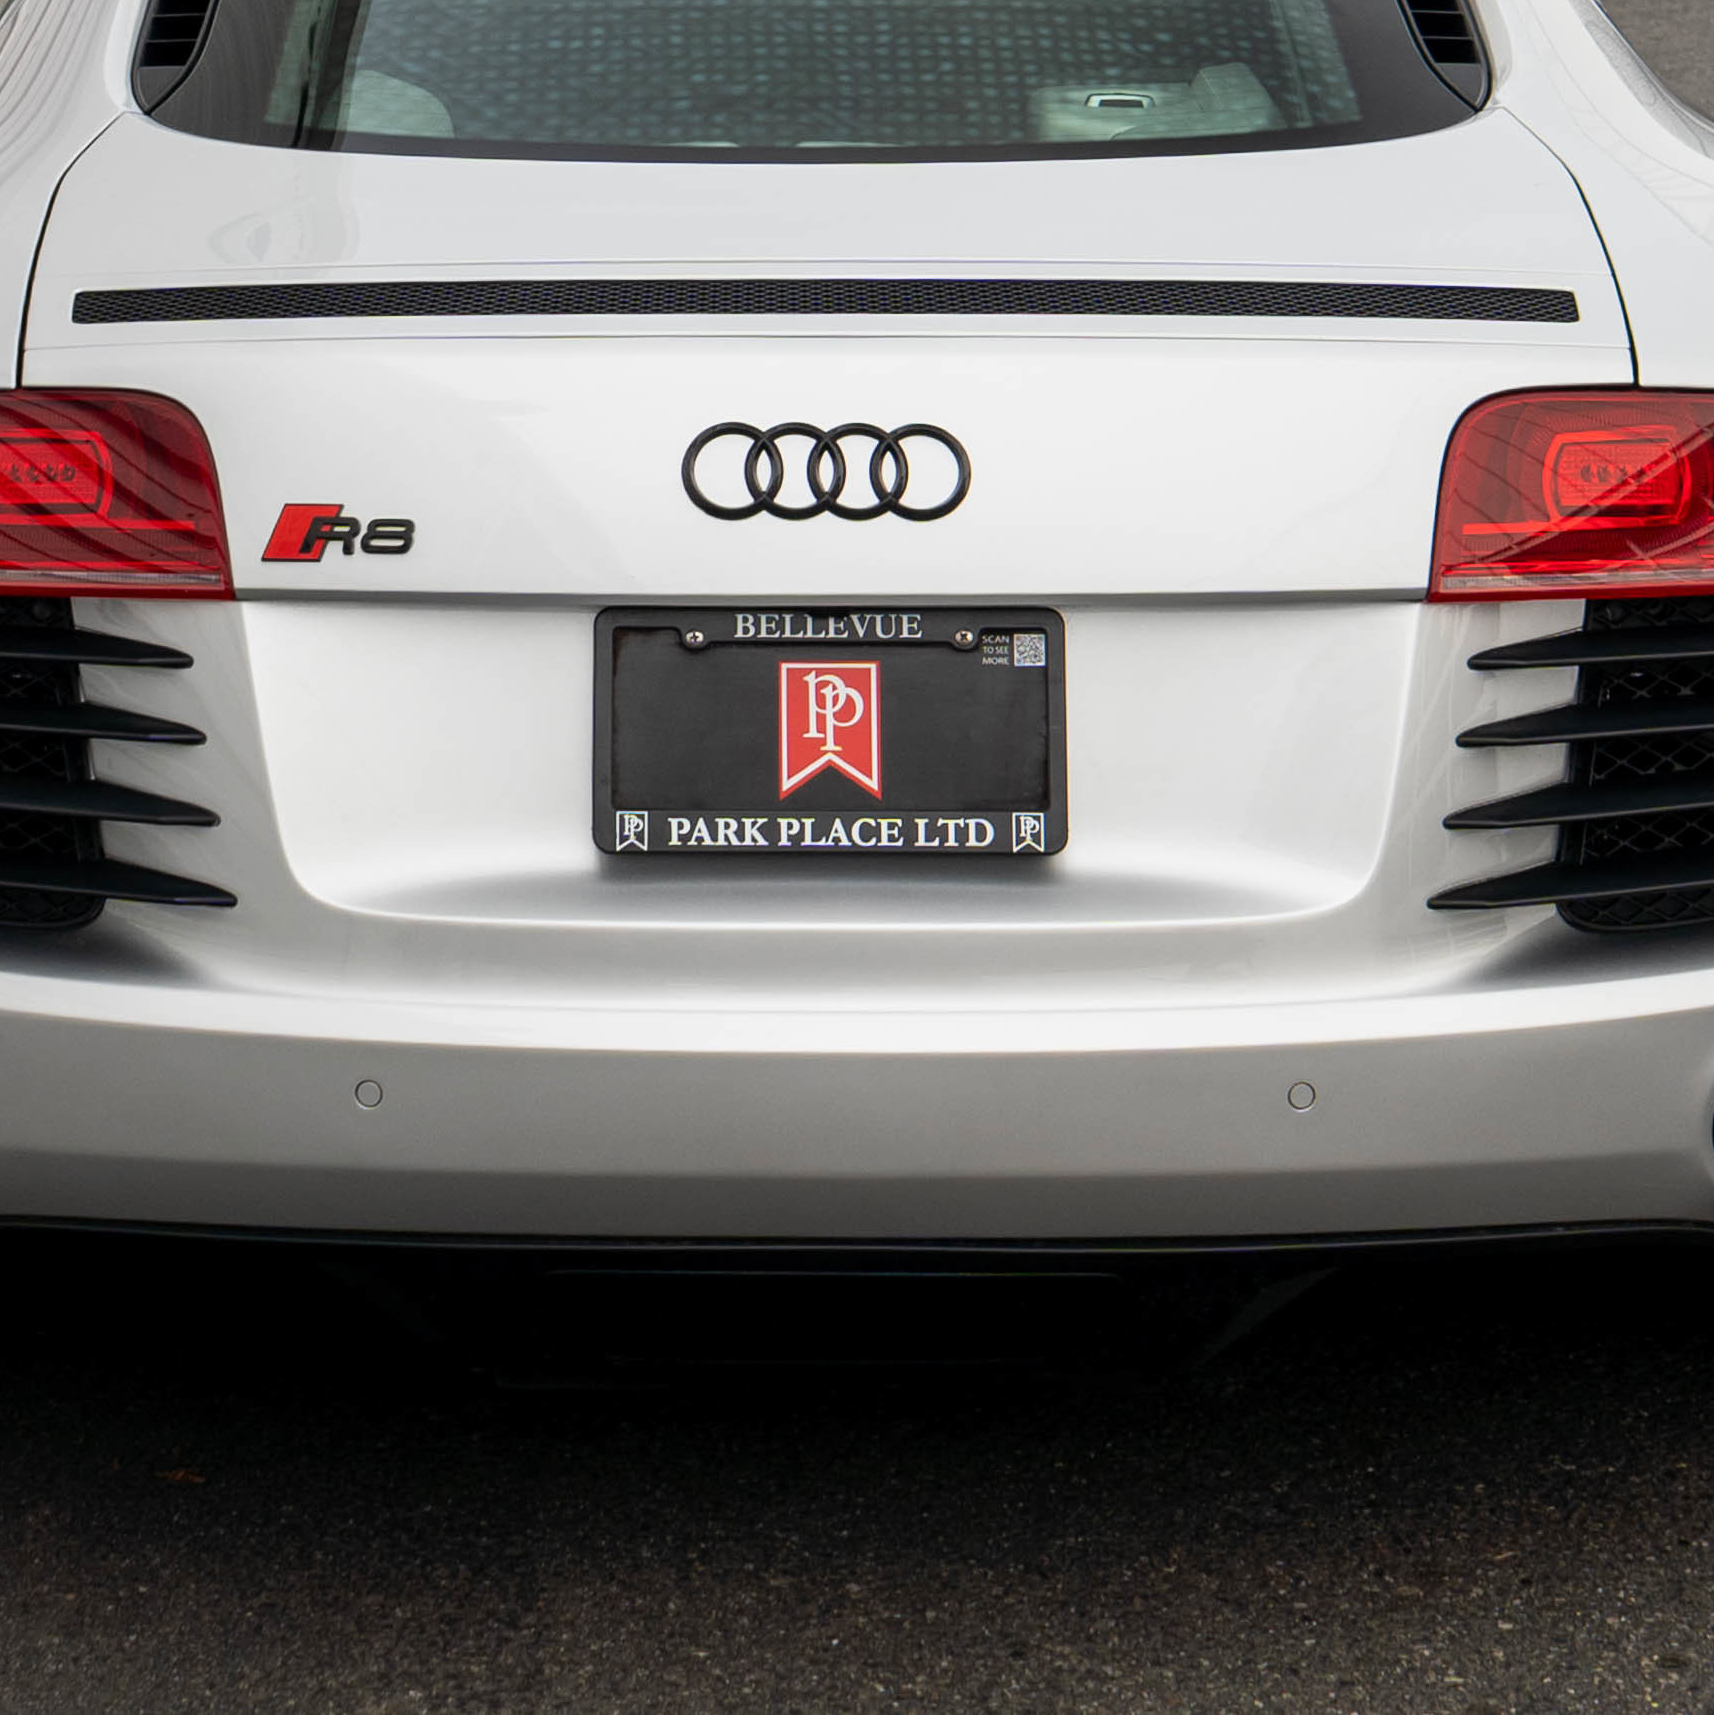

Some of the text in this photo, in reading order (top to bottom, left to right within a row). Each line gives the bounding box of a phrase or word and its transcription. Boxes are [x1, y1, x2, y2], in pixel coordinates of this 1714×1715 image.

[298, 516, 415, 556] R8
[733, 613, 924, 639] BELLEVUE
[981, 634, 1010, 644] SCAN
[982, 645, 1009, 654] TO SEE
[981, 656, 1010, 665] MORE
[667, 817, 996, 847] PARK PLACE LTD
